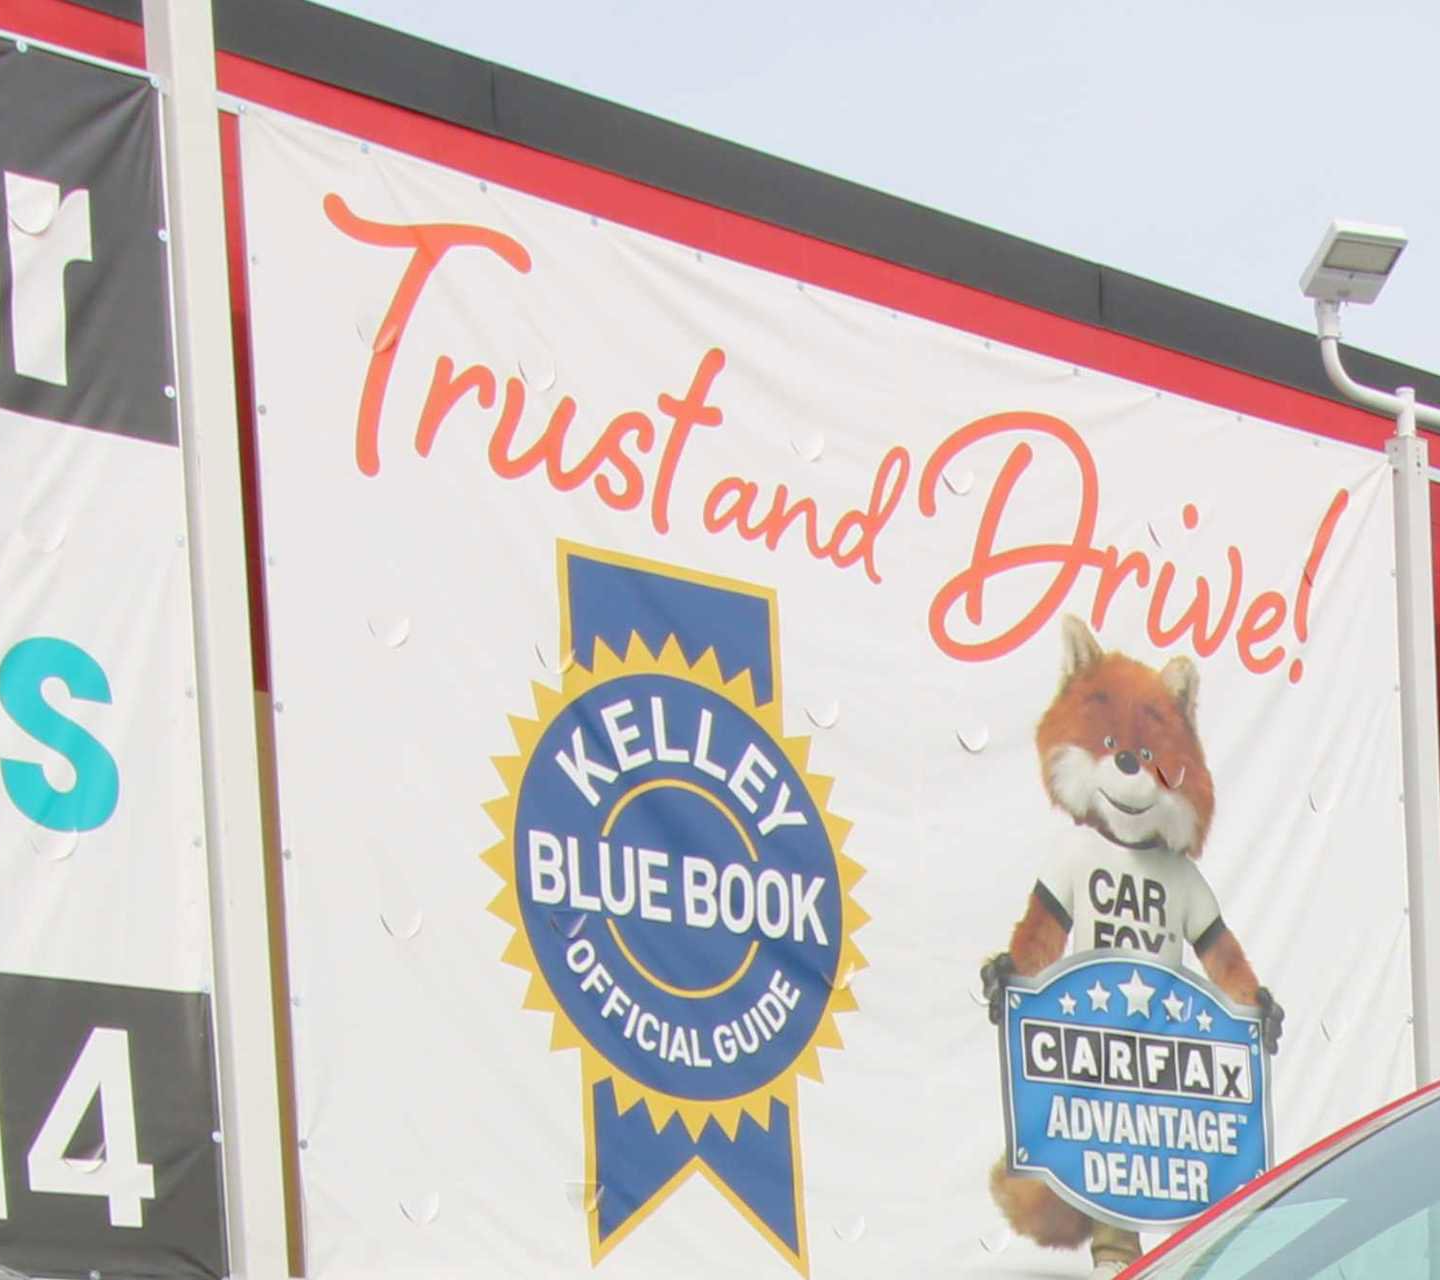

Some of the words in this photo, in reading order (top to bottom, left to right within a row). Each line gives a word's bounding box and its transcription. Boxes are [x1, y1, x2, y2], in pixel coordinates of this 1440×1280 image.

[323, 193, 723, 533] Trust
[704, 446, 909, 584] and
[919, 411, 1348, 683] Drive!
[555, 696, 808, 836] KELLEY
[528, 829, 672, 924] BLUE
[682, 855, 829, 946] BOOK
[1088, 868, 1166, 927] CAR
[566, 939, 712, 1067] OFFICIAL
[712, 970, 801, 1064] GUIDE
[1031, 1031, 1245, 1098] CARFAX
[1082, 1150, 1209, 1203] DEALER
